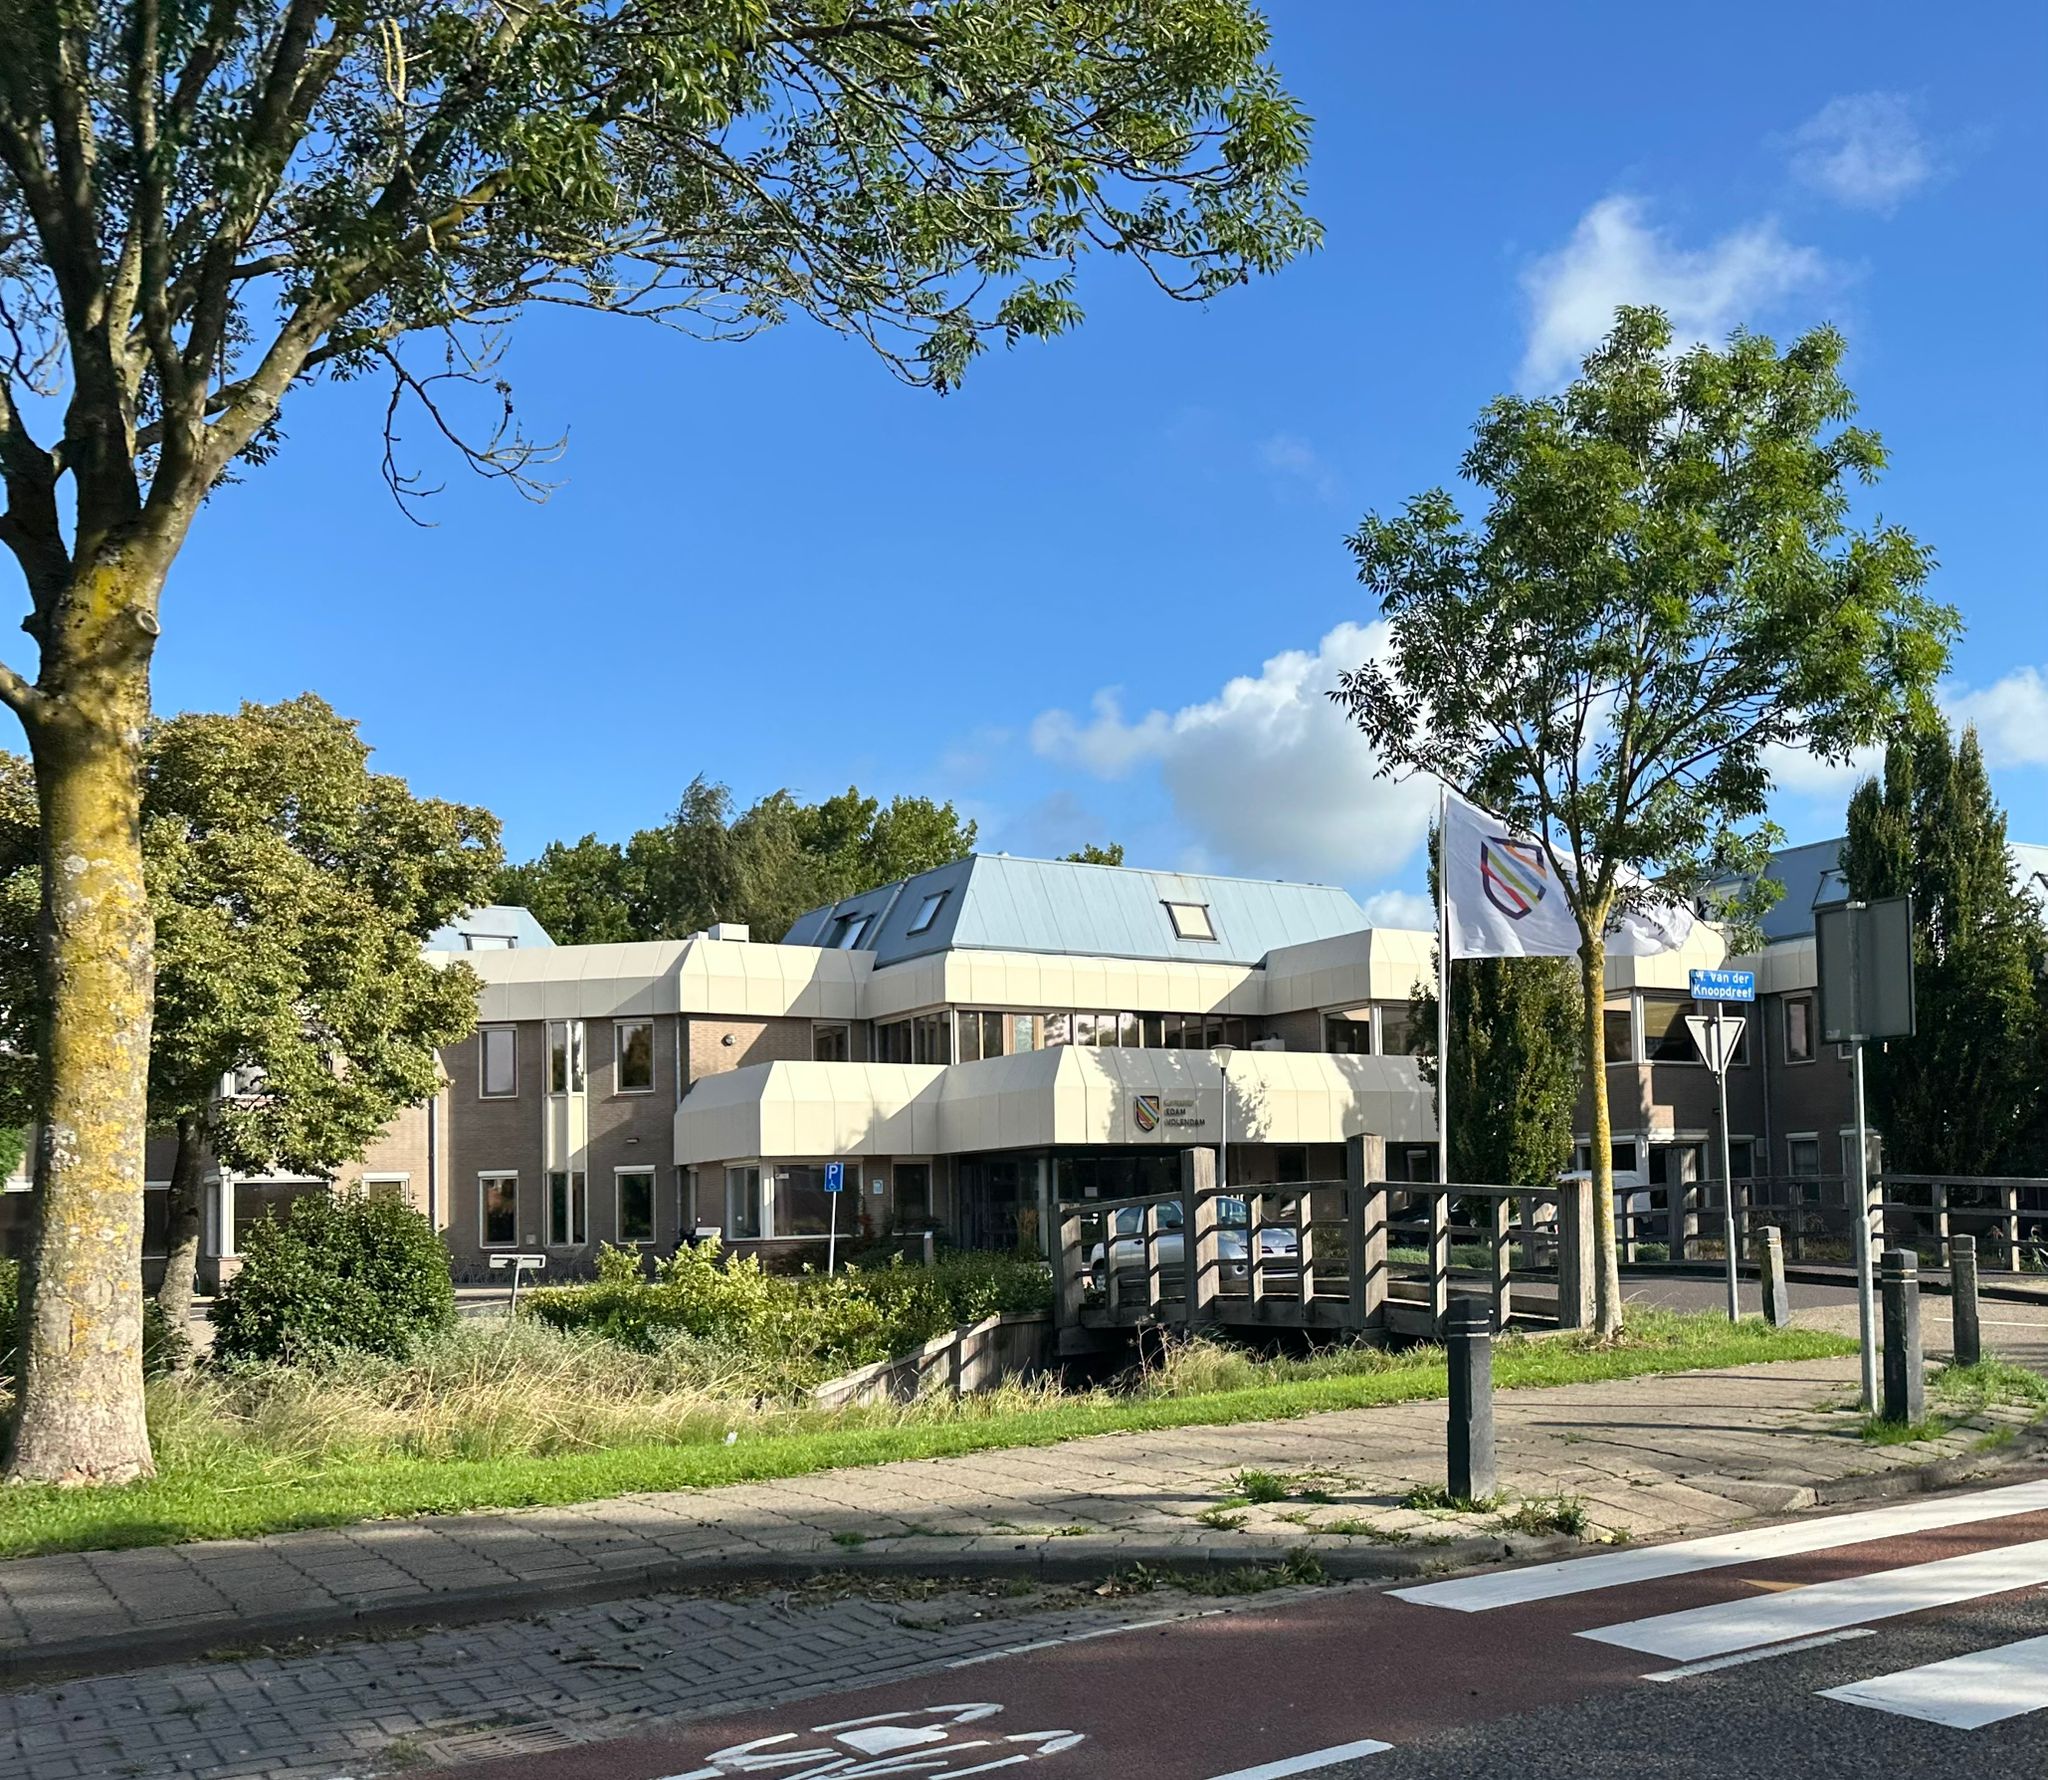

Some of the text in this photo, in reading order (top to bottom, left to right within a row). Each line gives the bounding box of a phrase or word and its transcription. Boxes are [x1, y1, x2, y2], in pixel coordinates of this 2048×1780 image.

[1732, 973, 1749, 984] der
[1693, 984, 1752, 998] Knoopdreef
[1164, 1108, 1186, 1116] EDAM
[828, 1165, 839, 1180] P
